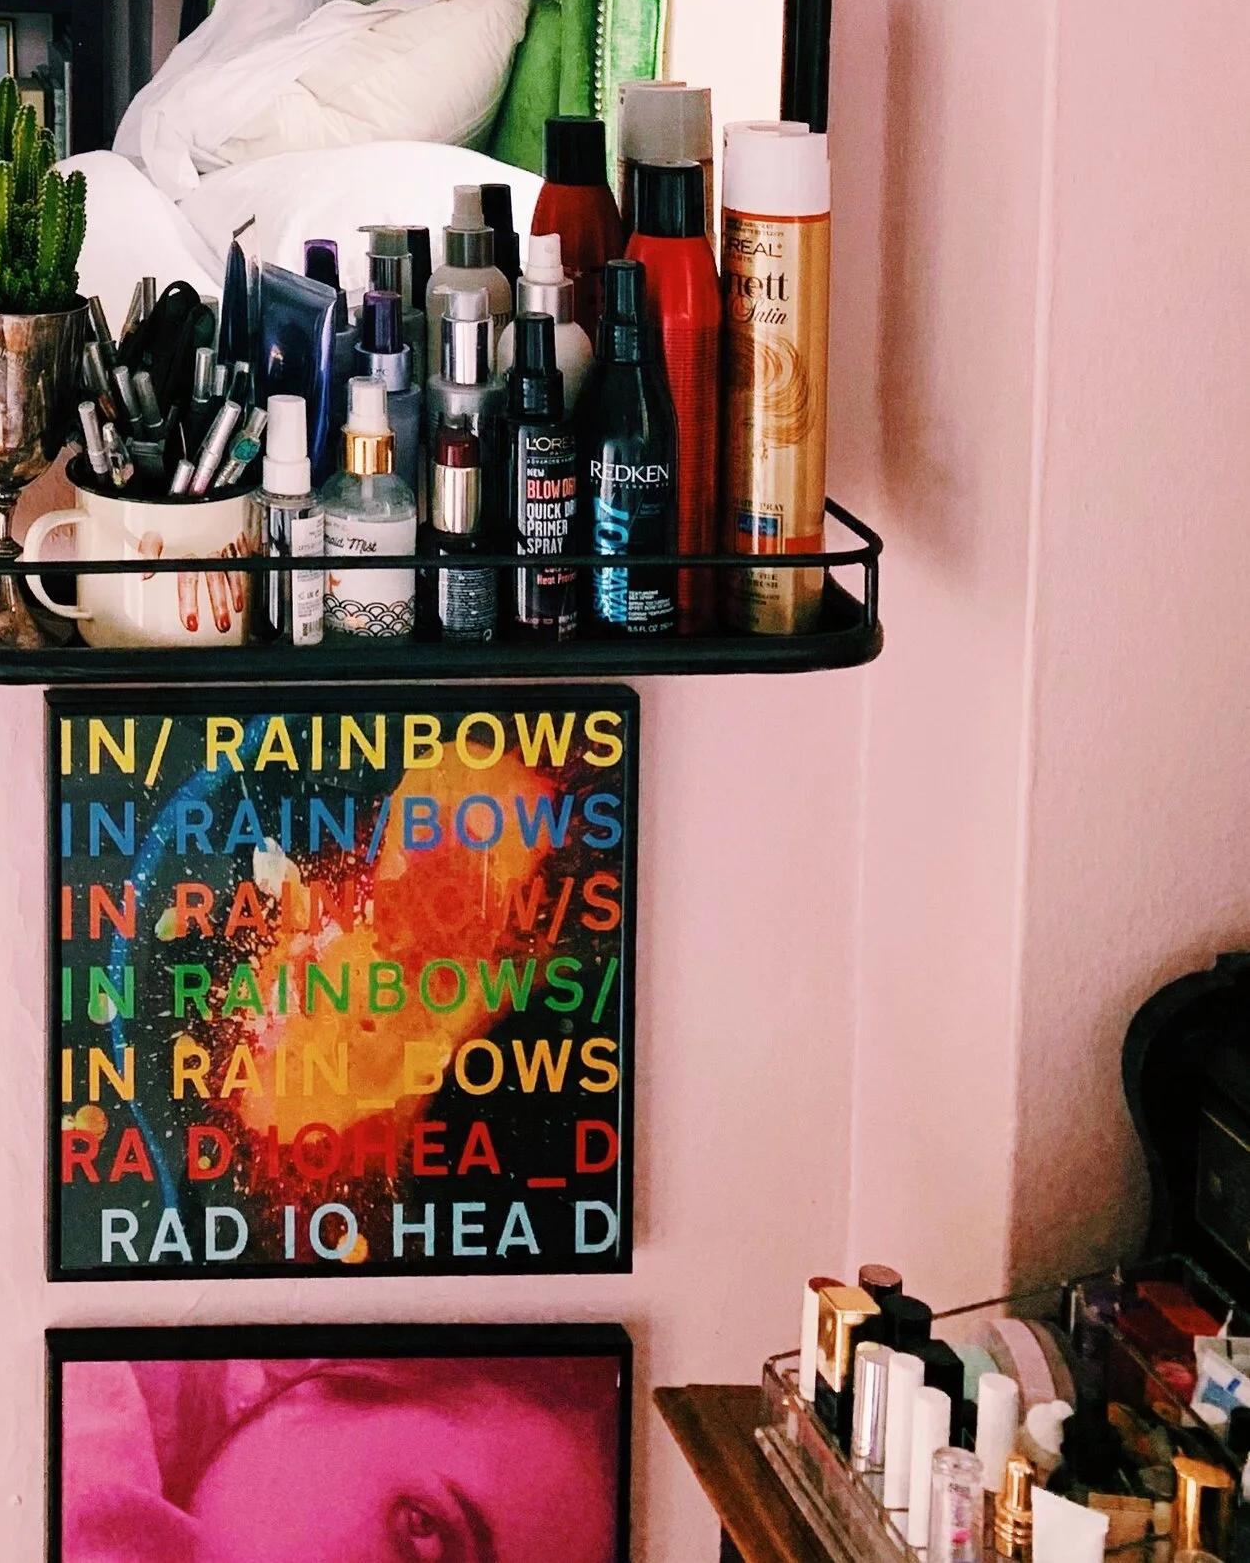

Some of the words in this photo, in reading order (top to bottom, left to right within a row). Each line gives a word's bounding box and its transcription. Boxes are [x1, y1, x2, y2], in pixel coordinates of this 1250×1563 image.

[730, 272, 789, 302] nett
[526, 468, 545, 477] NEW
[590, 459, 669, 483] REDKEN
[527, 479, 561, 500] BLOW
[526, 502, 561, 519] QUICK
[527, 519, 568, 536] PRIMER
[347, 537, 378, 554] Mist
[527, 538, 563, 554] SPRAY
[60, 716, 173, 787] IN/
[206, 711, 623, 772] RAINBOWS
[60, 801, 135, 857] IN
[175, 794, 622, 863] RAIN/BOWS
[60, 882, 136, 940] IN
[60, 964, 135, 1021] IN
[173, 957, 618, 1022] RAINBOWS/
[60, 1047, 135, 1102] IN
[100, 1207, 248, 1263] RAD
